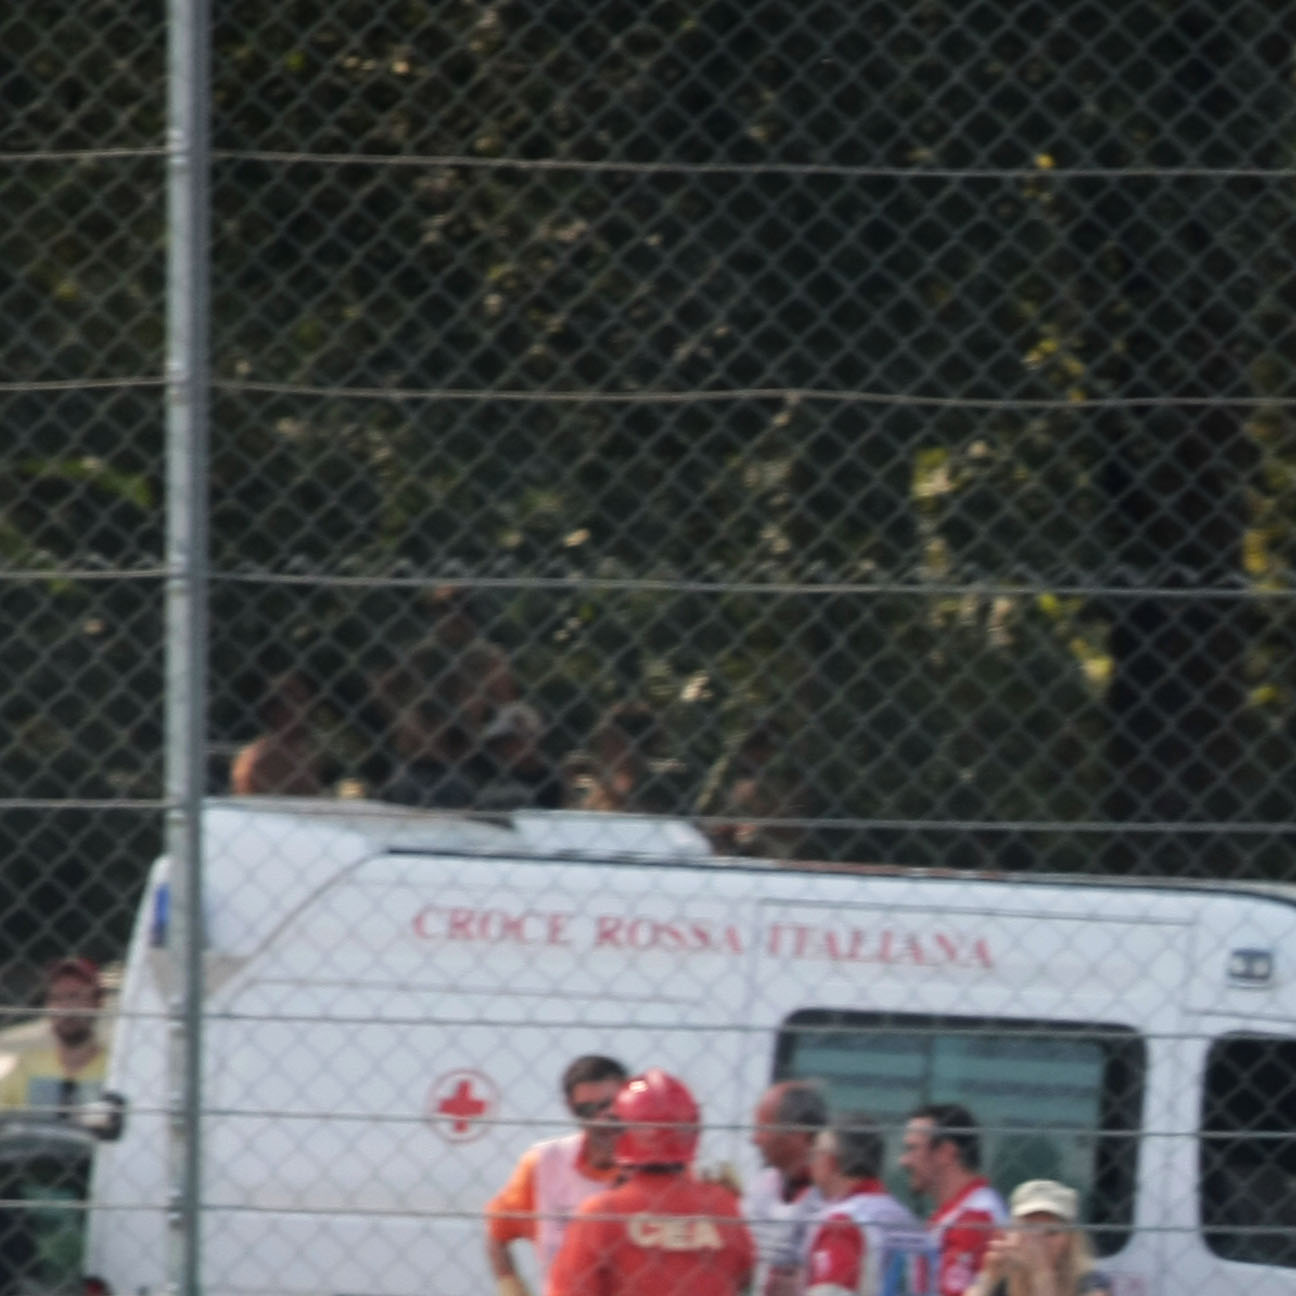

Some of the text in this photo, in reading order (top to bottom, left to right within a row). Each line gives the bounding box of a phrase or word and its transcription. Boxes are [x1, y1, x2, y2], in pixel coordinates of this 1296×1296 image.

[412, 907, 994, 968] CROCE ROSSA ITALIANA
